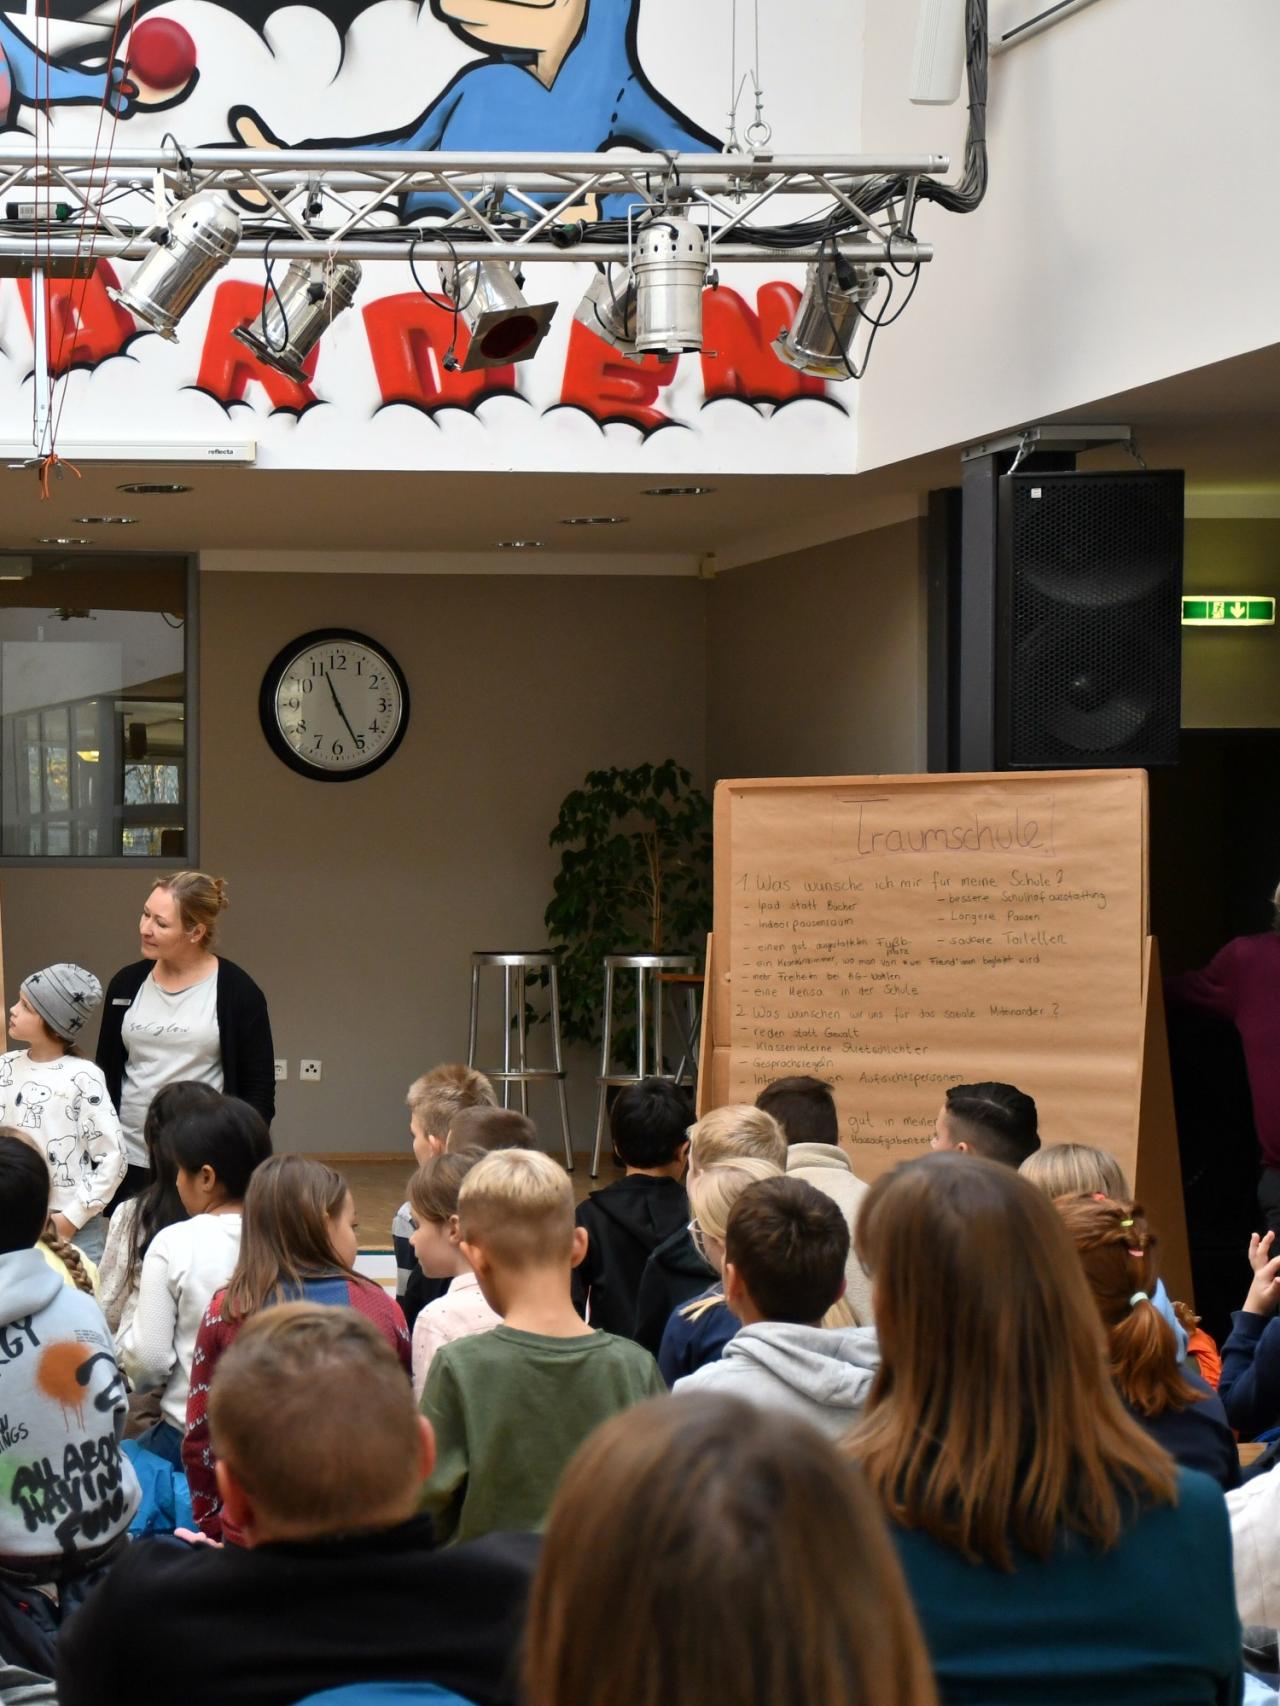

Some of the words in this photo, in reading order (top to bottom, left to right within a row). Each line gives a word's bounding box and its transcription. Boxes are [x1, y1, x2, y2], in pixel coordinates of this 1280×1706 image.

[312, 661, 324, 677] 11
[328, 655, 347, 670] 12
[356, 661, 362, 676] 1
[296, 678, 313, 694] 10
[368, 675, 379, 690] 2
[289, 697, 300, 712] 9
[378, 697, 387, 713] 3
[296, 719, 307, 734] 8
[368, 719, 379, 733] 4
[314, 734, 323, 750] 7
[331, 740, 343, 756] 6
[356, 734, 365, 749] 5
[756, 873, 792, 892] Was
[875, 875, 895, 890] ich
[900, 877, 922, 889] mir
[961, 875, 998, 888] meine
[790, 898, 818, 911] statt
[1007, 910, 1041, 922] Pausen
[752, 1005, 780, 1019] Was
[824, 1026, 860, 1039] Gewalt
[847, 1110, 874, 1134] gut
